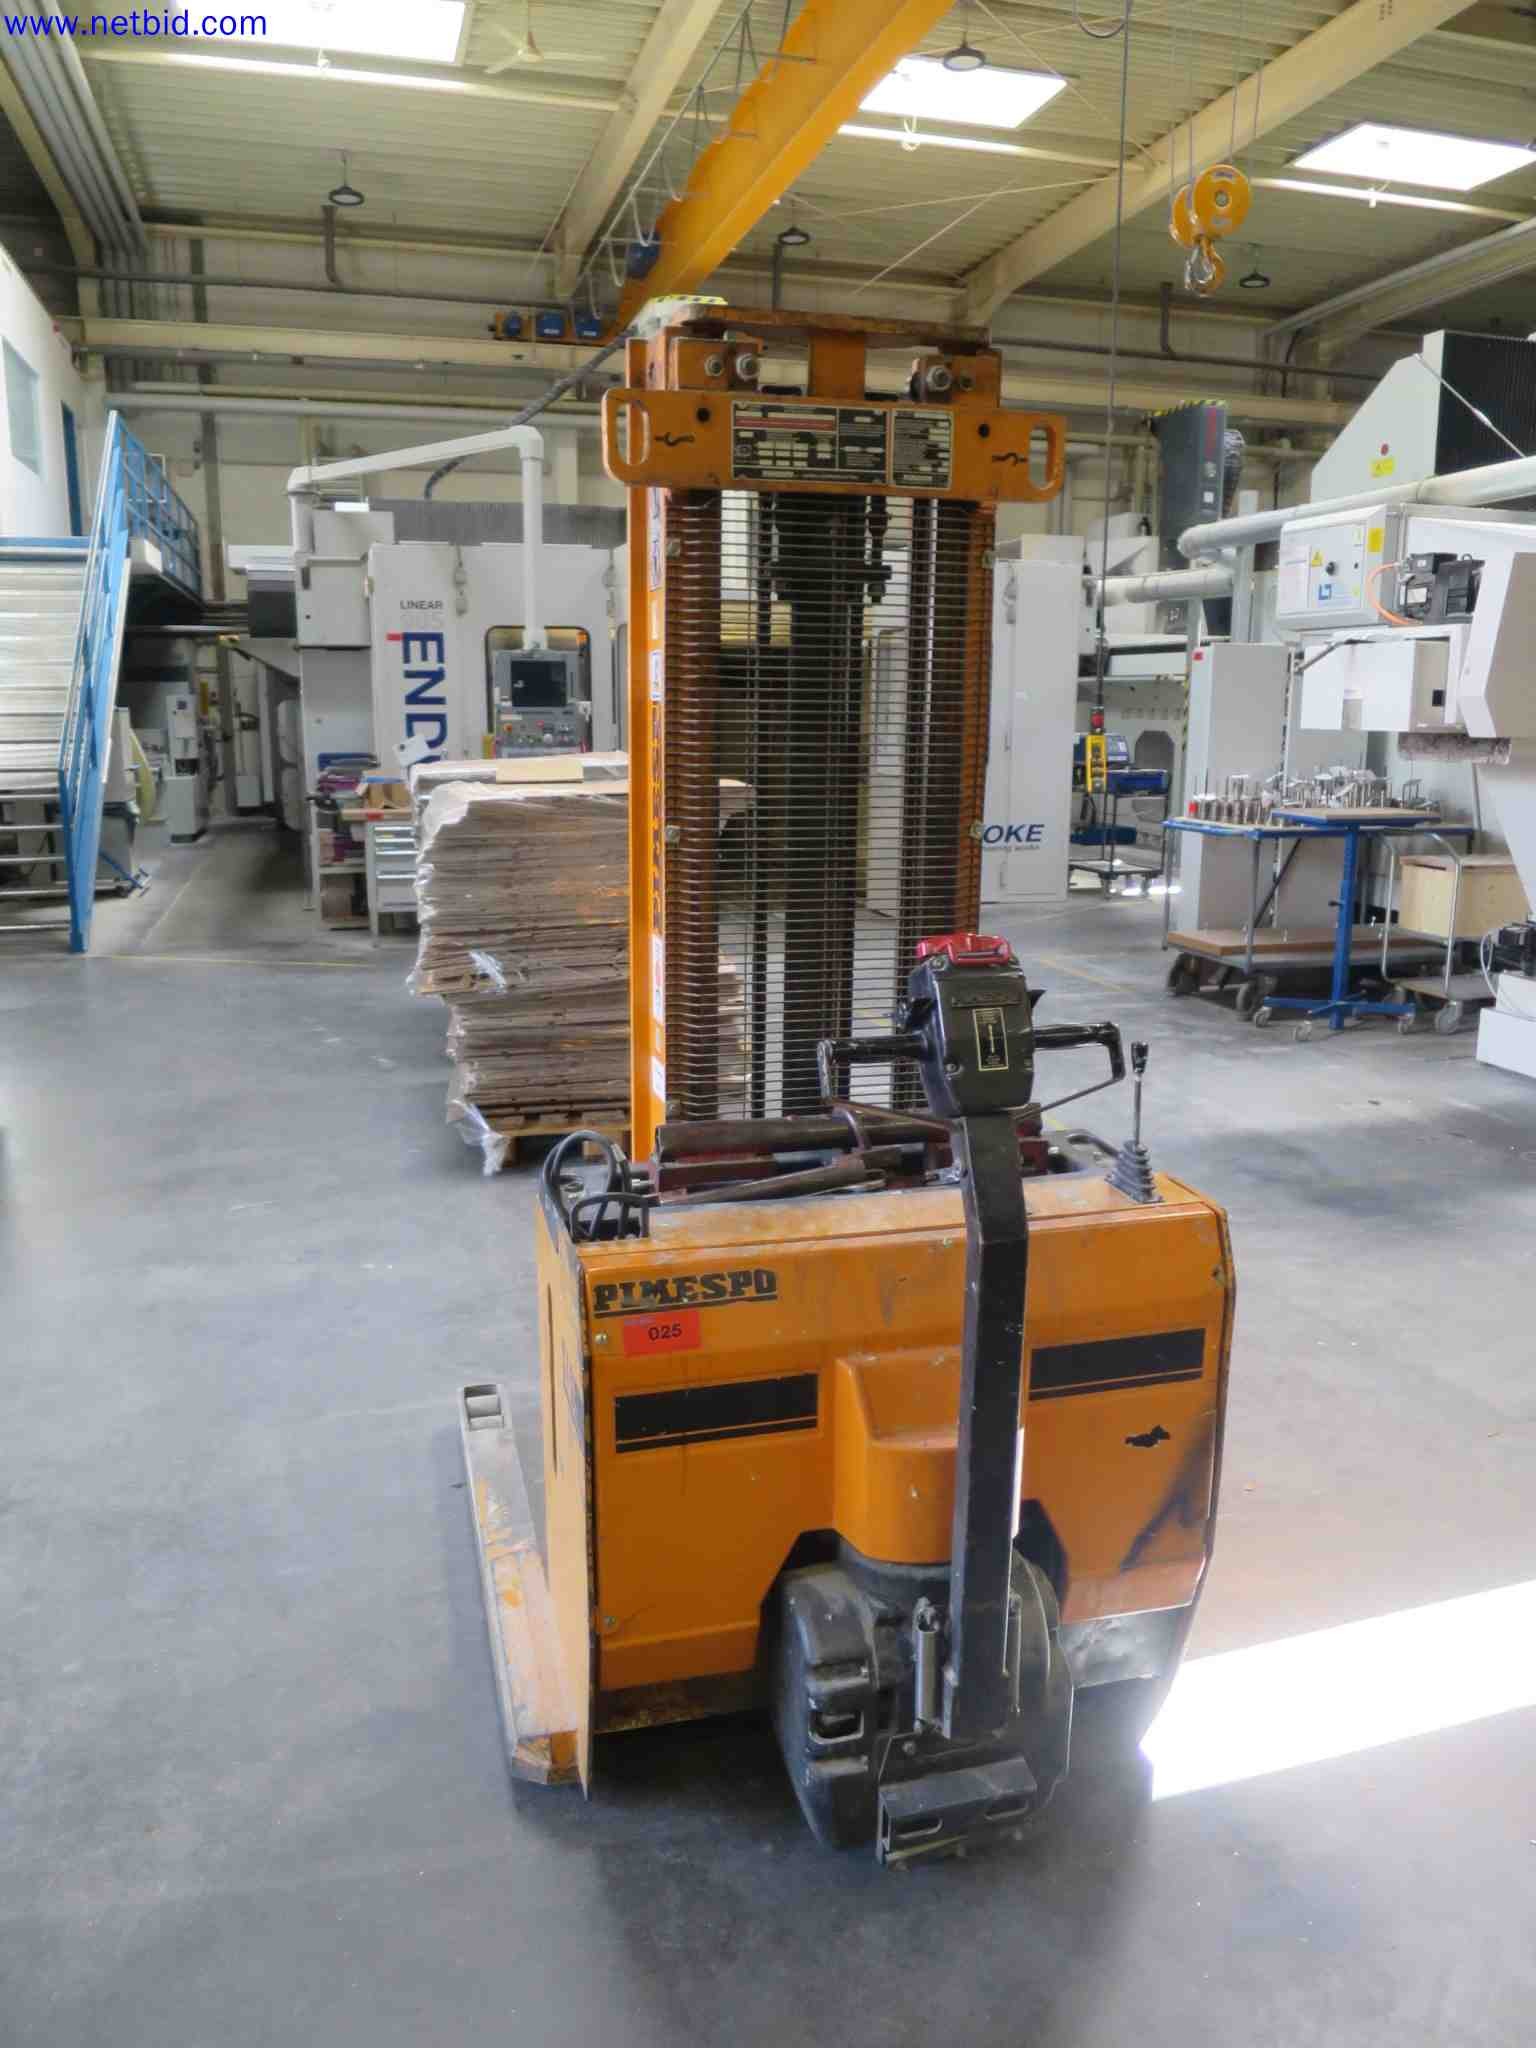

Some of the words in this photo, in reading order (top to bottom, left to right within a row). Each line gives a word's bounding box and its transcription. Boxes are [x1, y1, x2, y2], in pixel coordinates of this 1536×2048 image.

[400, 600, 444, 610] LINEAR
[593, 1268, 777, 1312] PIMESPO
[648, 1323, 683, 1341] 025
